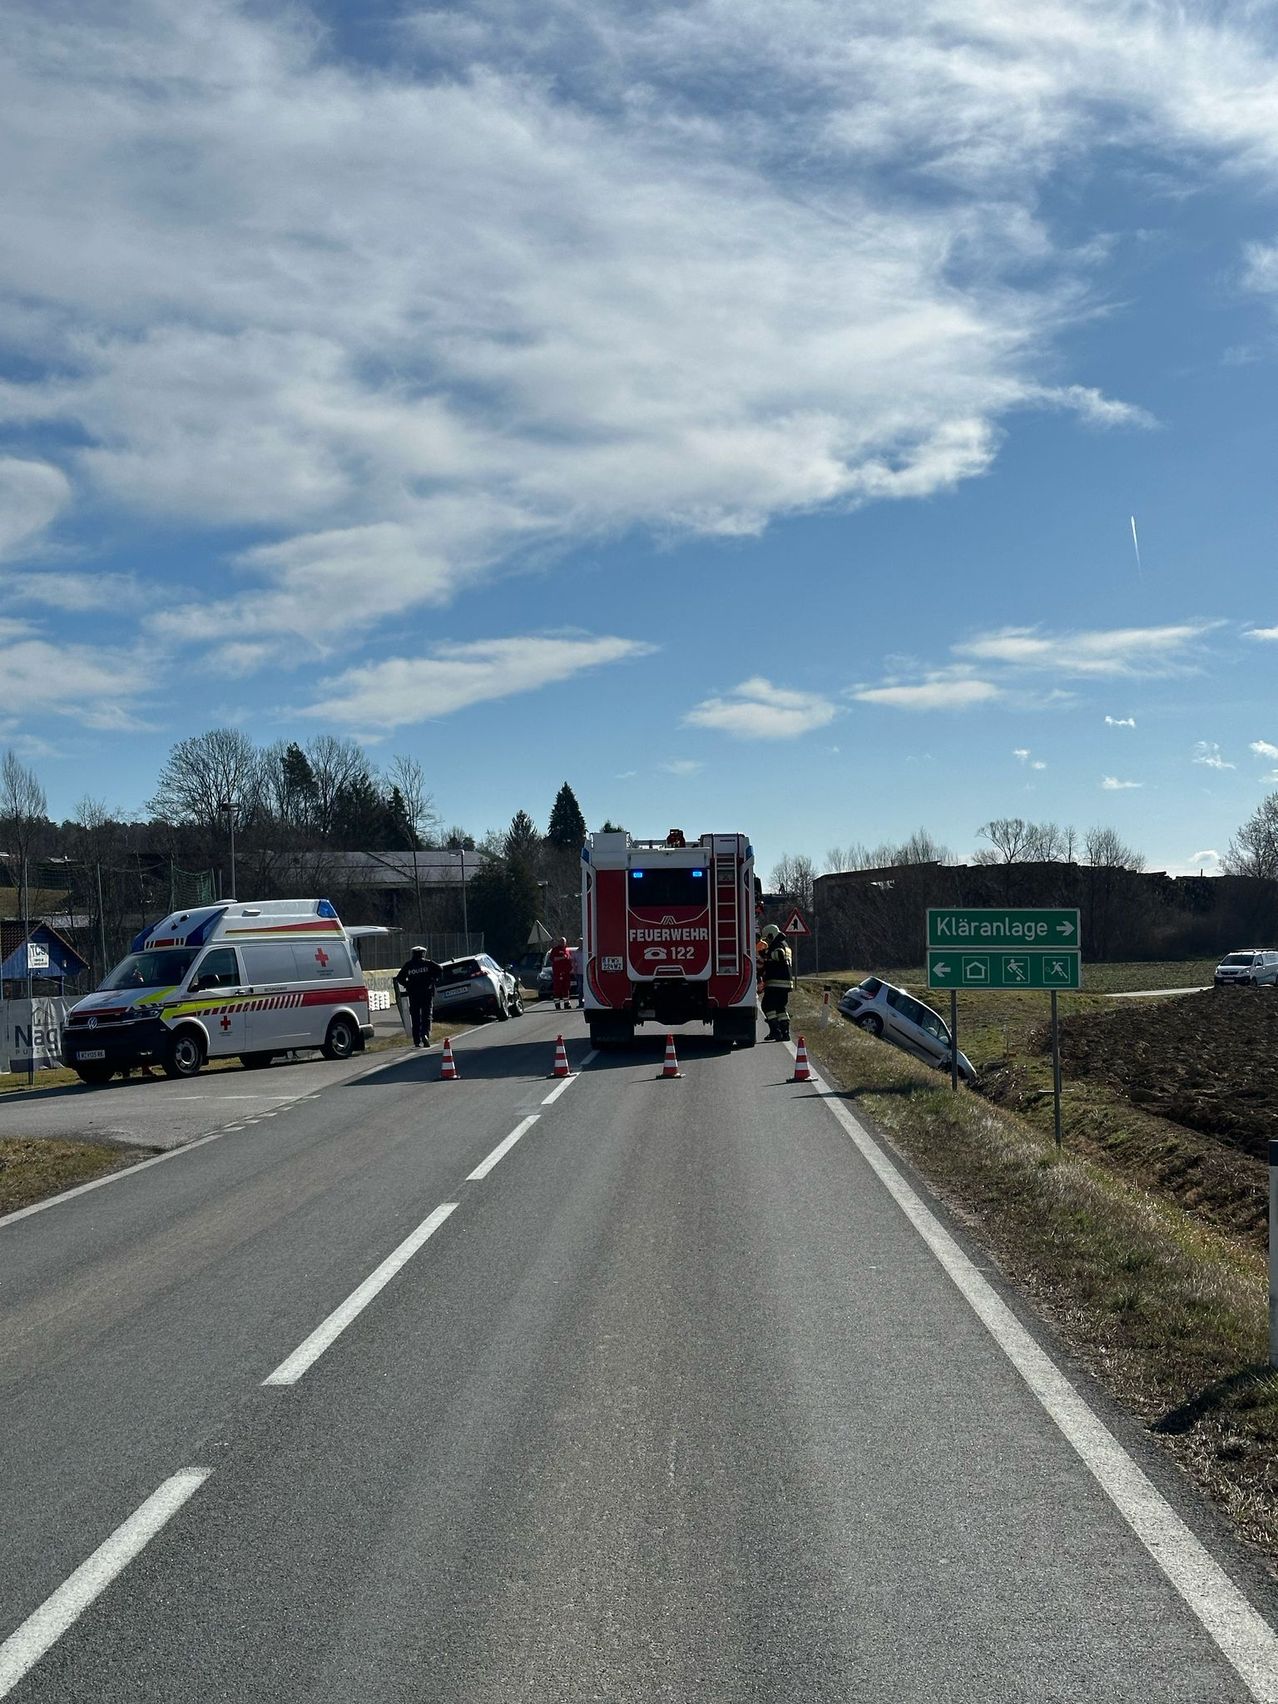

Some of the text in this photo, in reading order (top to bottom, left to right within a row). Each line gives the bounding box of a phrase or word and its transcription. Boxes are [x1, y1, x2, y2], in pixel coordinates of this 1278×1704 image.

[629, 928, 708, 942] FEUERWEHR
[936, 916, 1048, 941] Kläranlage
[670, 946, 695, 960] 122
[408, 966, 430, 975] POLIZEI
